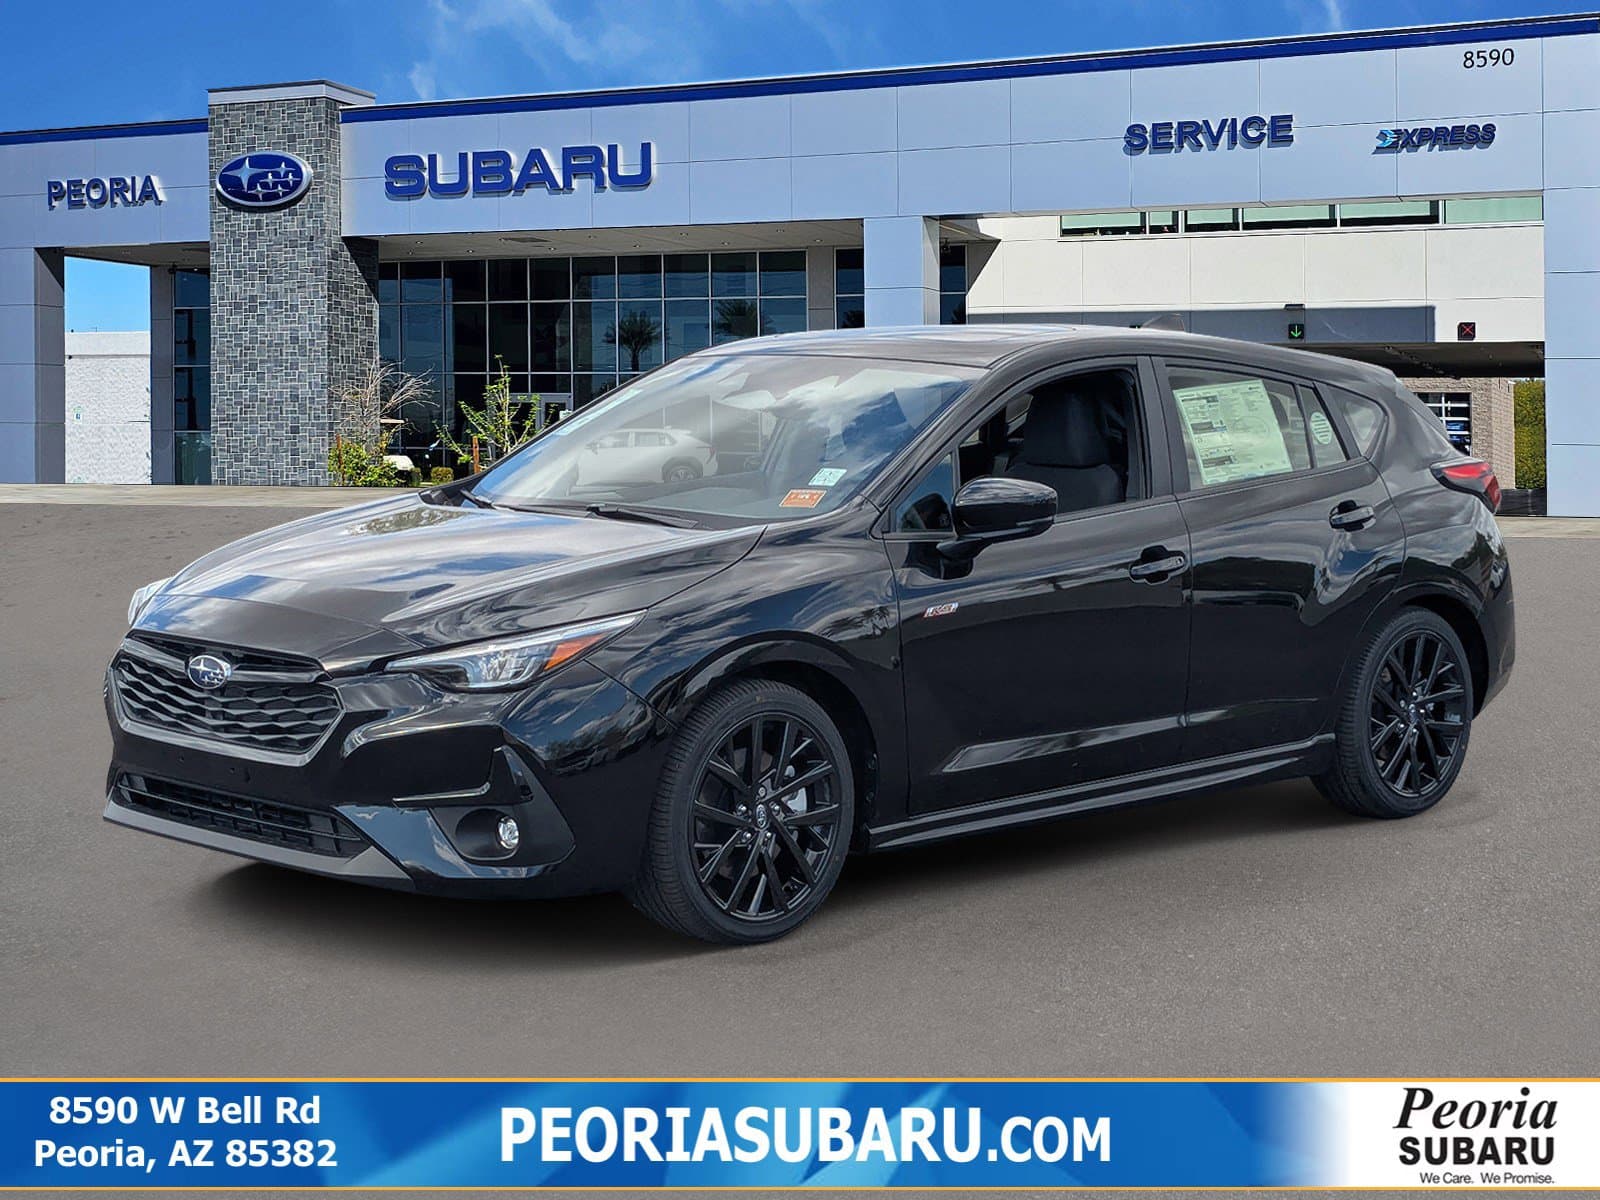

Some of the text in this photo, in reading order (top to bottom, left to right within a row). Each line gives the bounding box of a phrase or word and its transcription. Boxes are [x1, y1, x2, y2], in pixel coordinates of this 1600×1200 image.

[1463, 48, 1515, 69] 8590
[1124, 114, 1294, 153] SERVICE
[1375, 123, 1496, 153] EXPRESS
[384, 142, 652, 198] SUBARU
[48, 175, 163, 209] PEORIA
